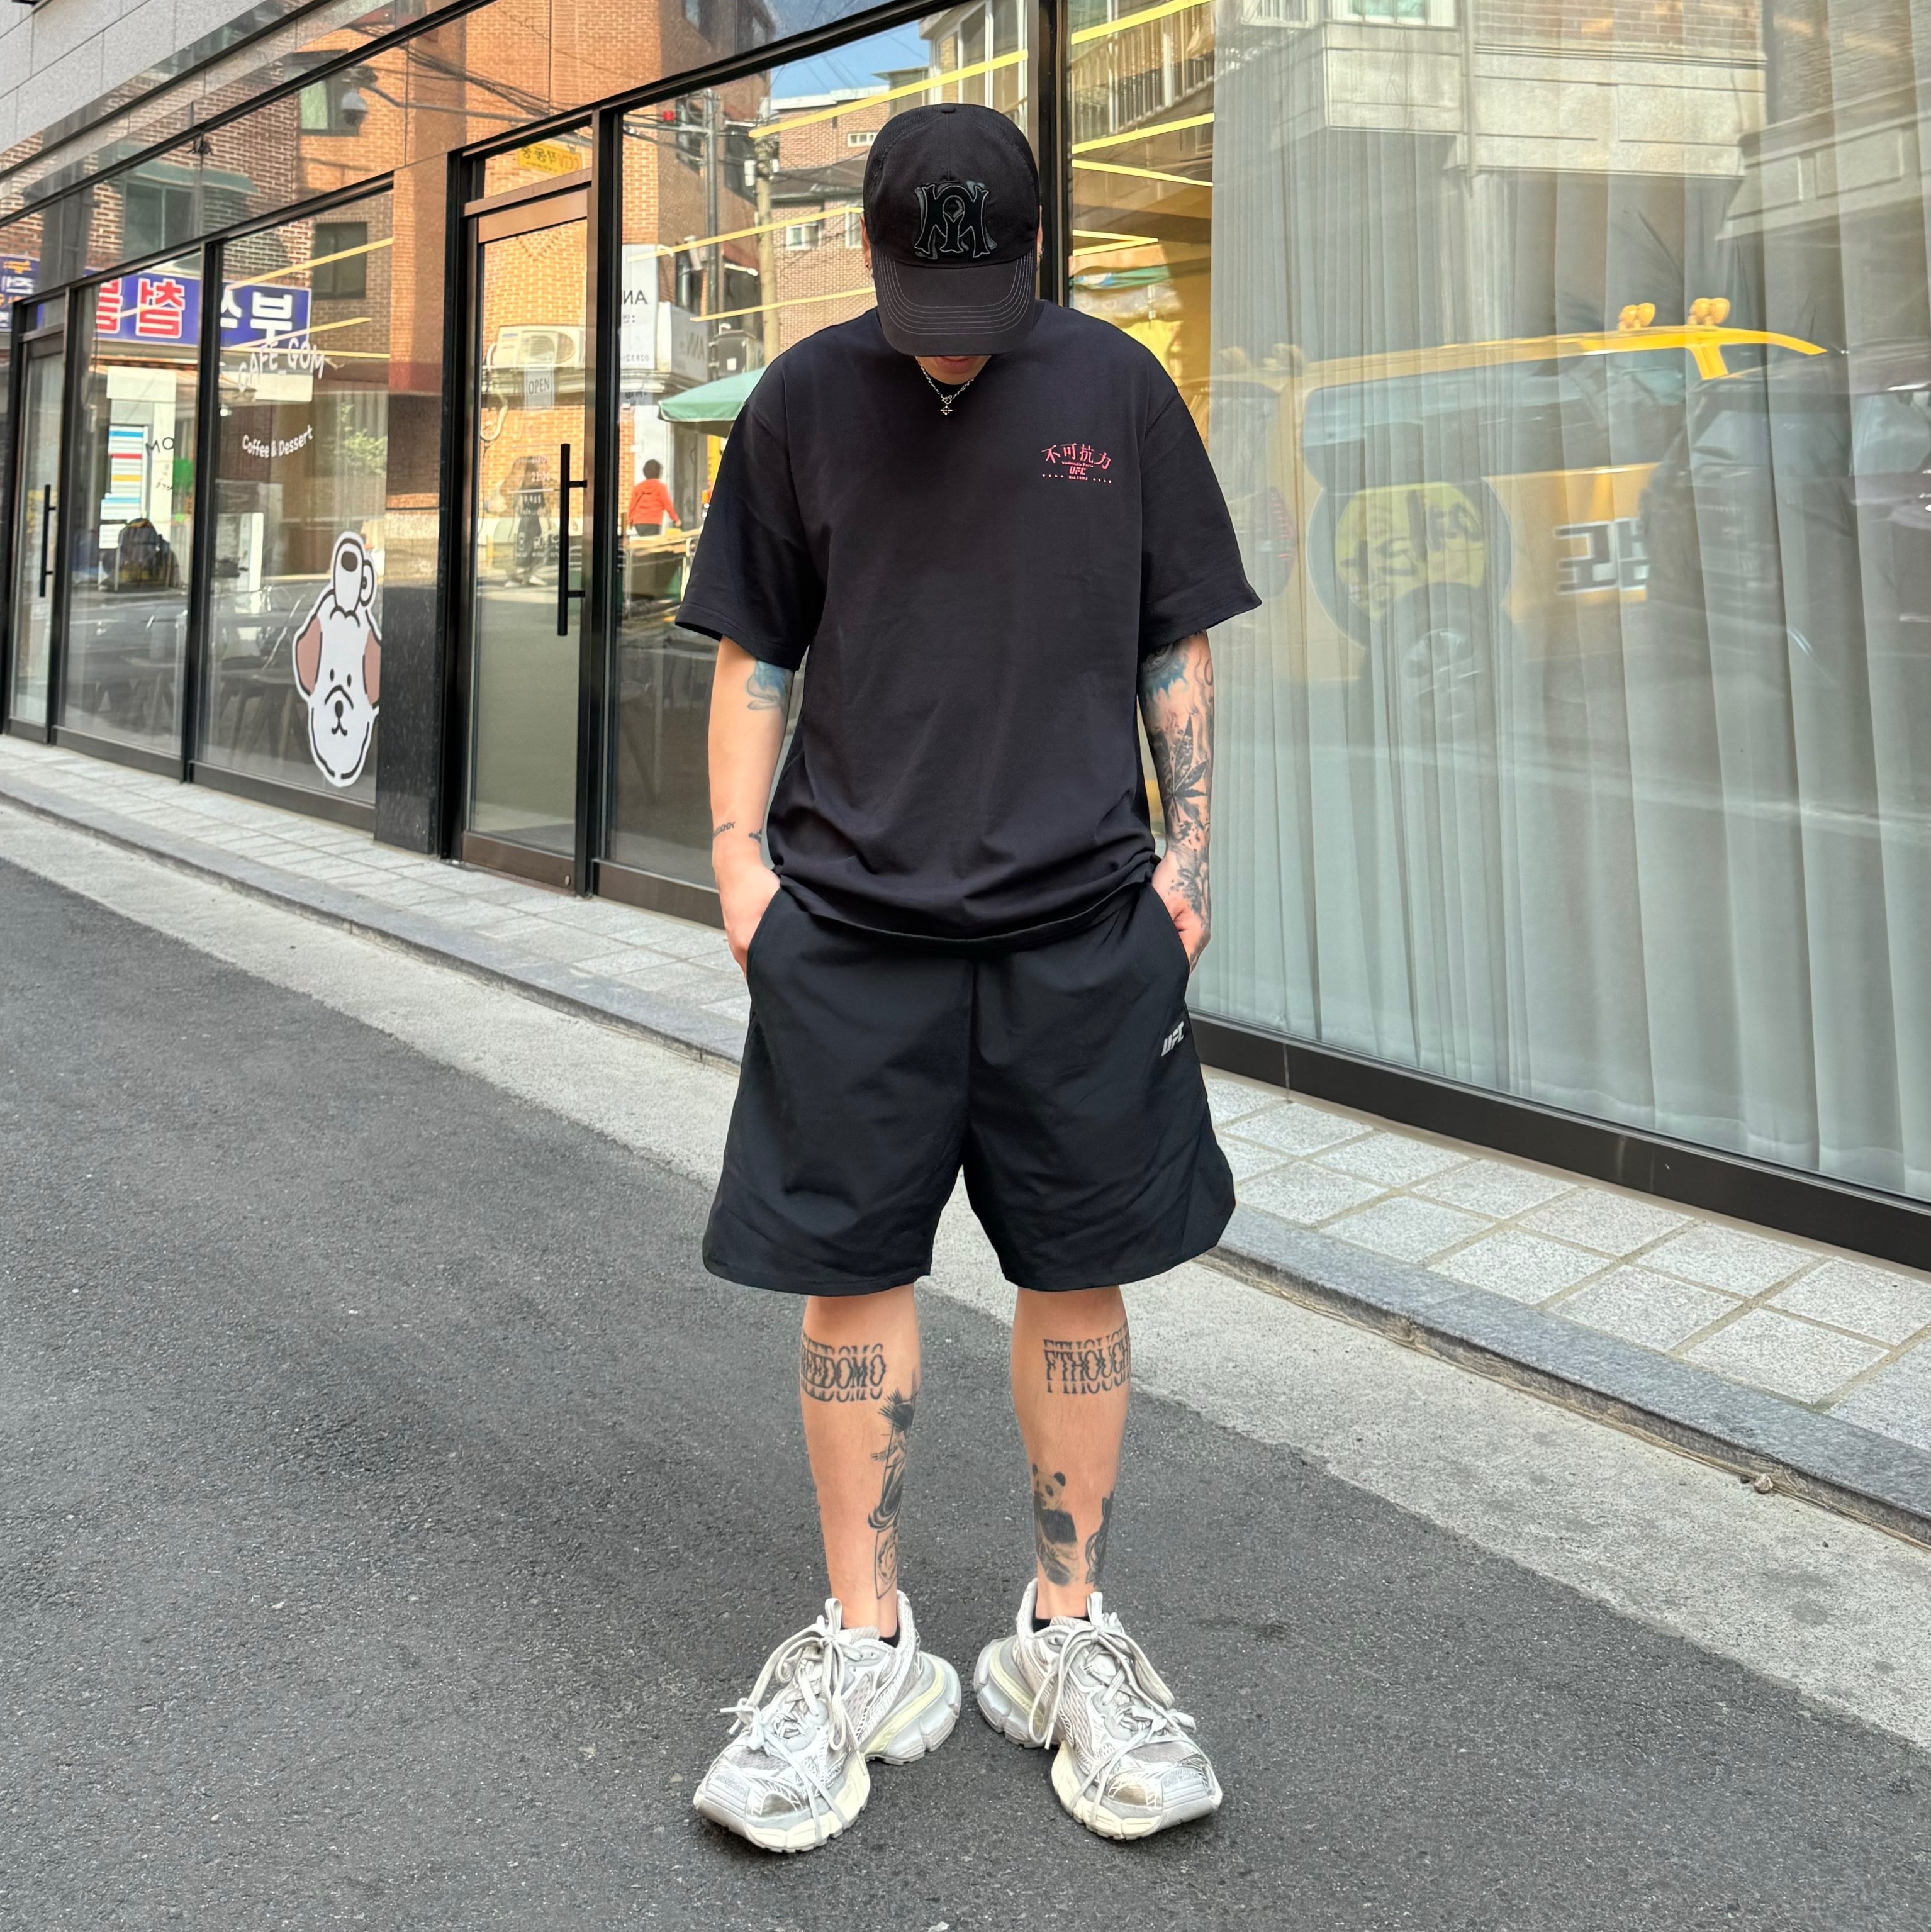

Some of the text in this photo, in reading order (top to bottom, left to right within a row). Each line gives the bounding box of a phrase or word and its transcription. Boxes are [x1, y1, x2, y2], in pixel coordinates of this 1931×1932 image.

[528, 378, 550, 395] OPEN
[242, 434, 270, 458] Coffee
[279, 424, 313, 457] Dessert
[1041, 442, 1111, 469] 不可抗力
[1069, 466, 1086, 475] UFC
[1161, 1020, 1184, 1057] UFC
